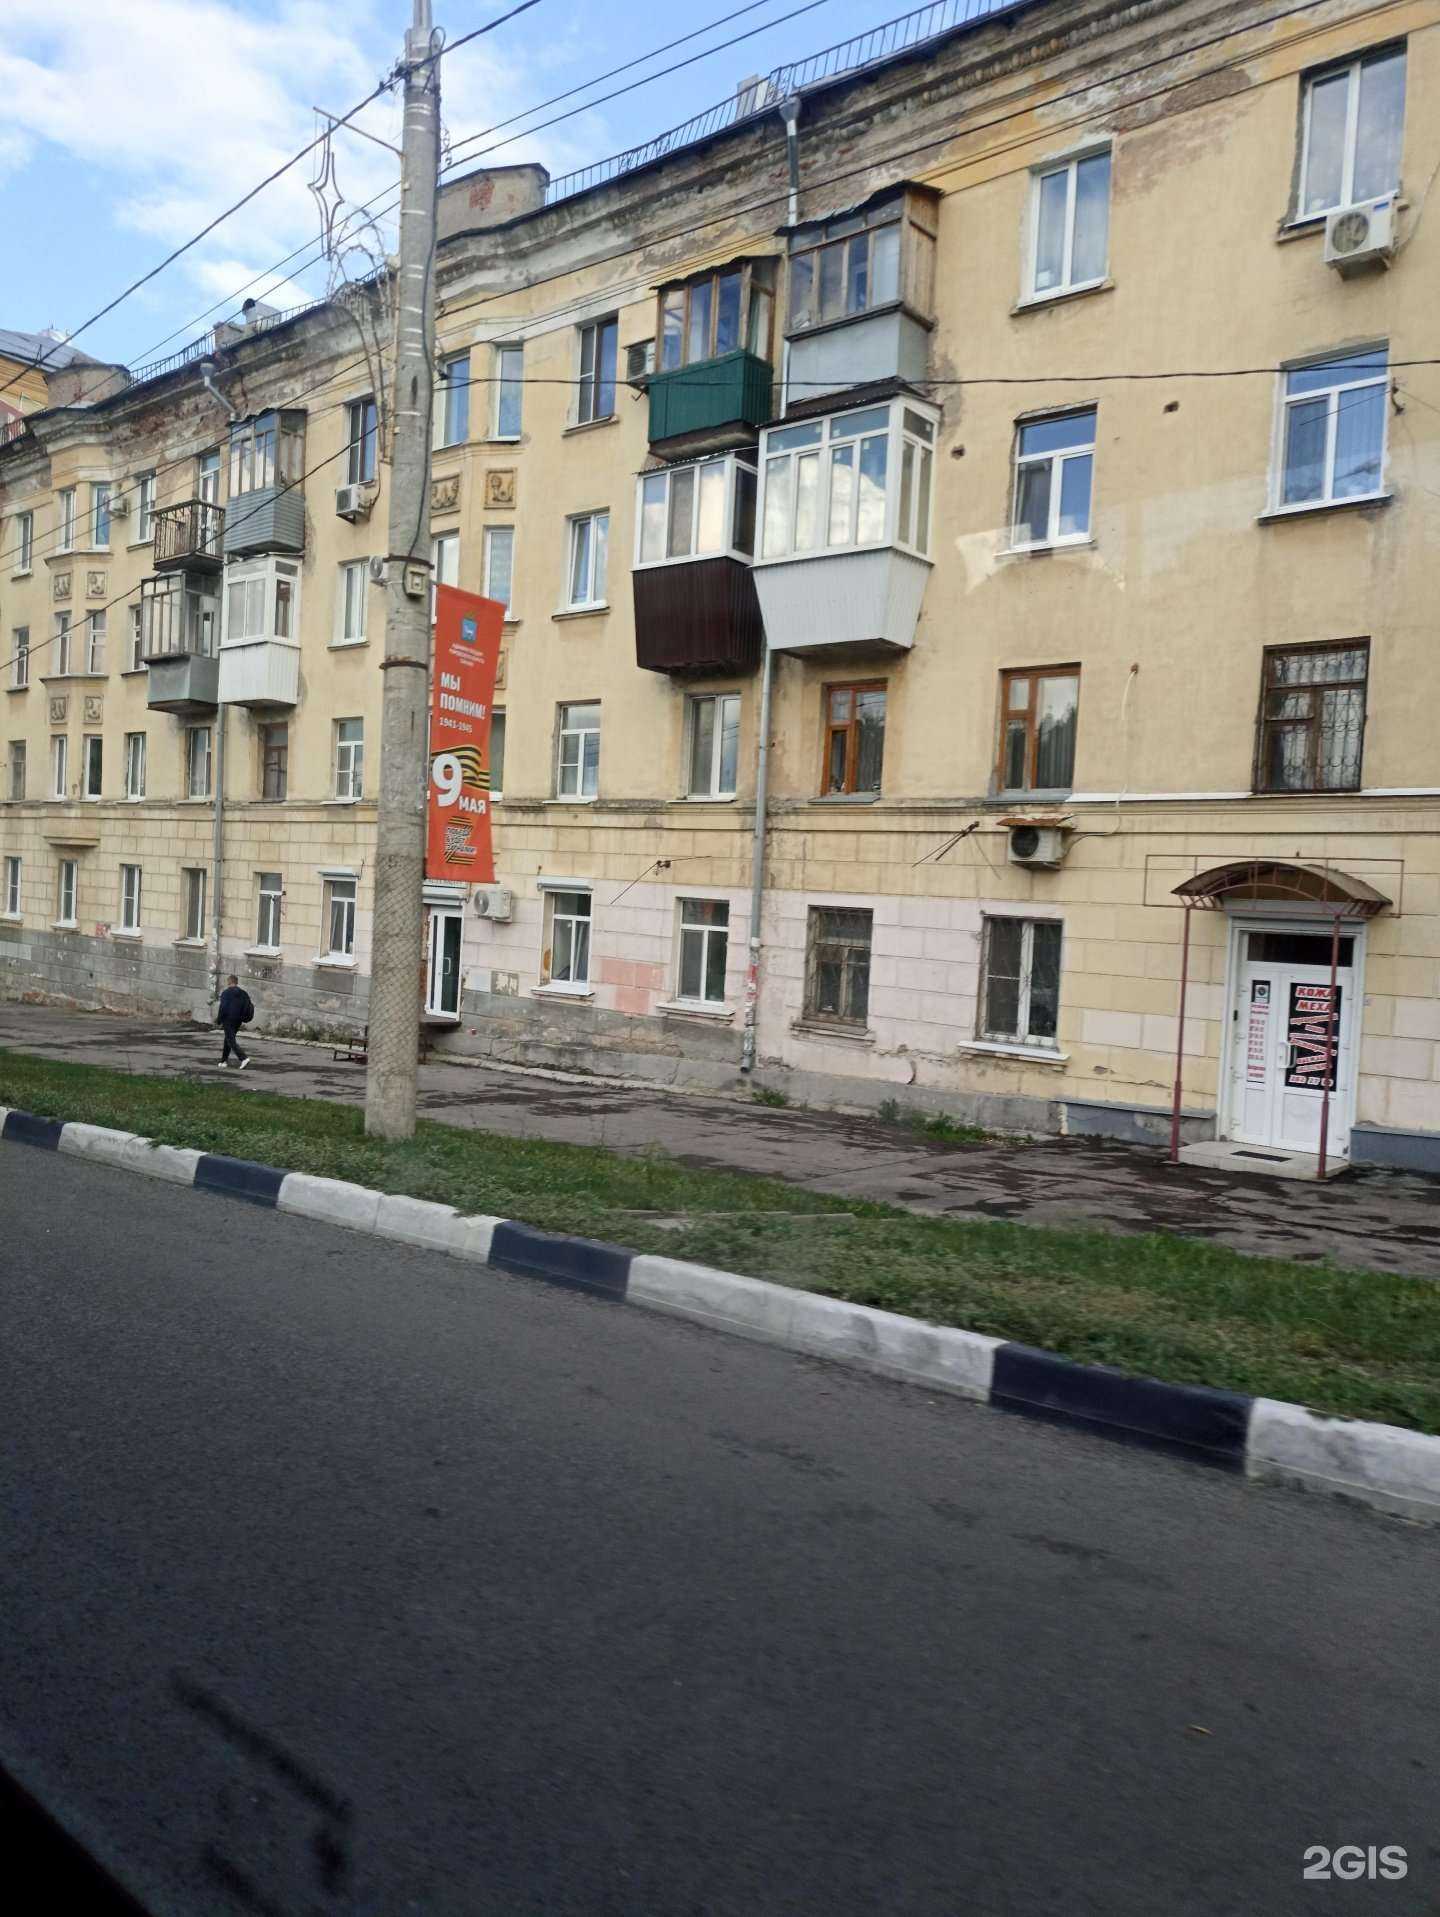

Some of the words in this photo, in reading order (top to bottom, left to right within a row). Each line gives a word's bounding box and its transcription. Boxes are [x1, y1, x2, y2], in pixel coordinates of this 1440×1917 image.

[440, 671, 461, 692] МЫ
[439, 692, 486, 720] ПОМНИМ!
[432, 753, 463, 807] 9
[459, 796, 486, 814] МАЯ
